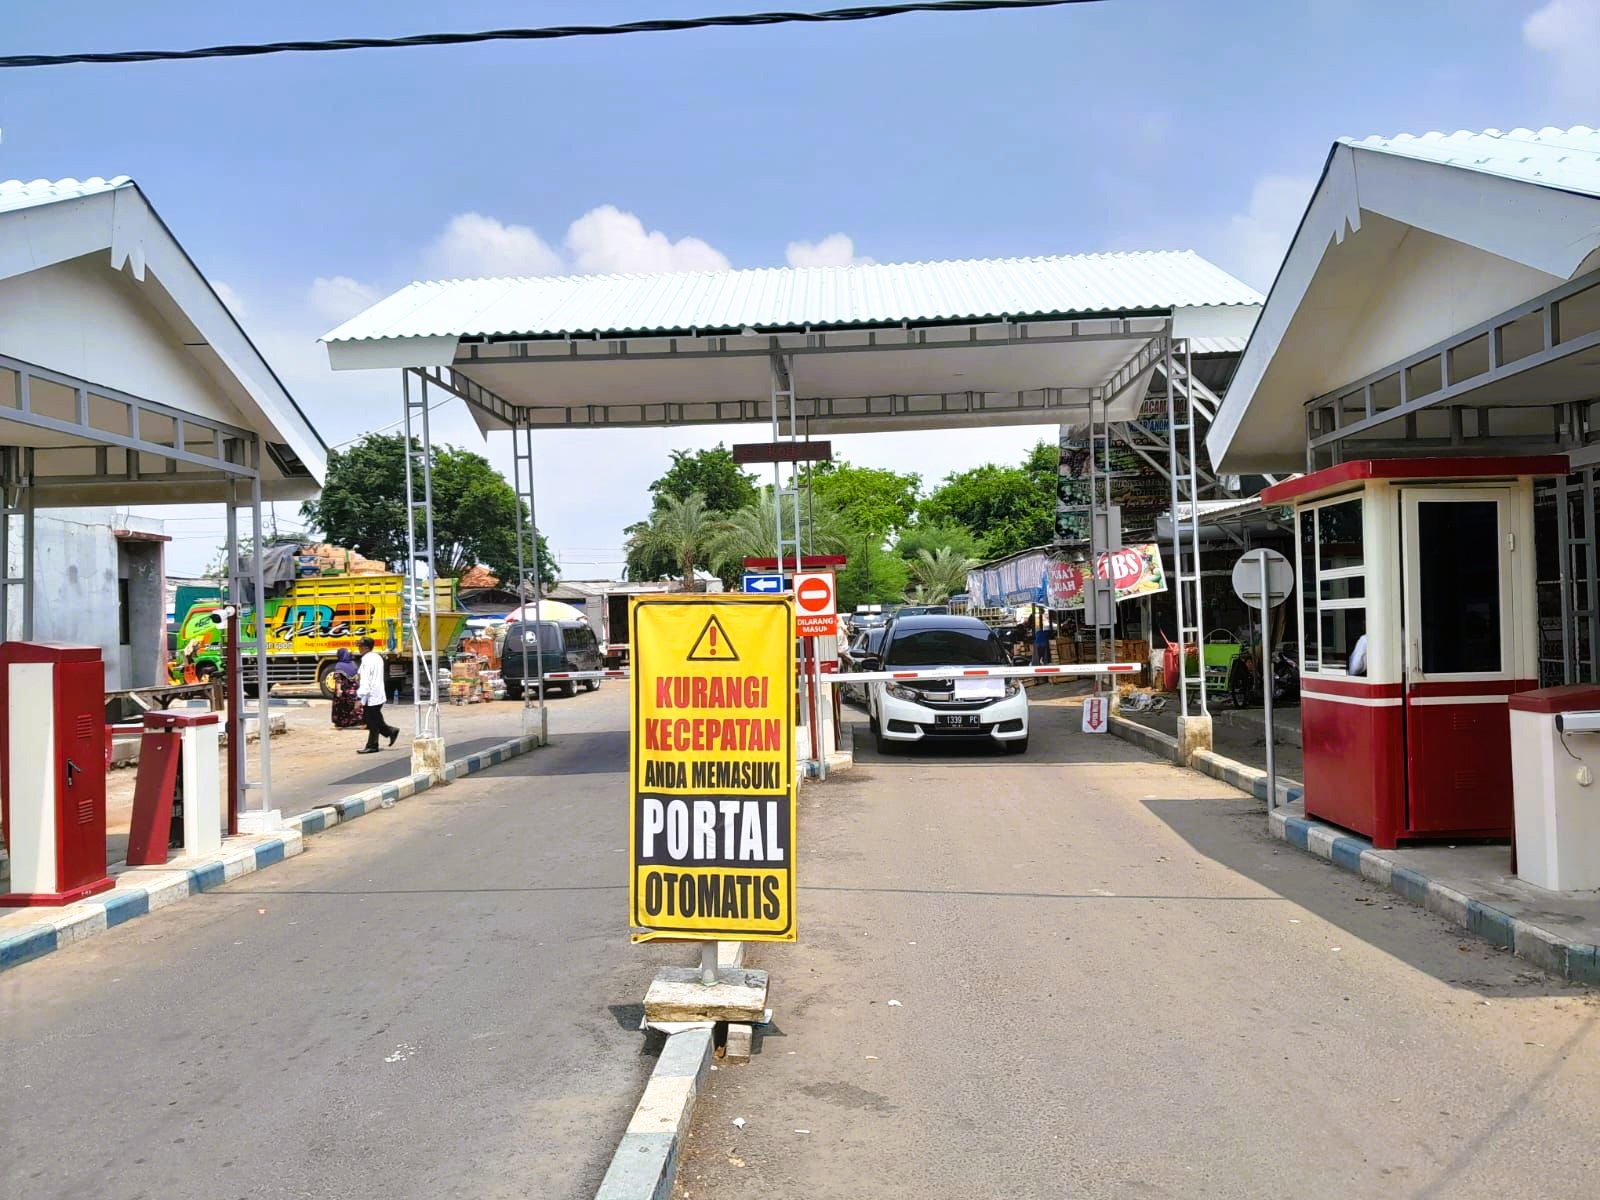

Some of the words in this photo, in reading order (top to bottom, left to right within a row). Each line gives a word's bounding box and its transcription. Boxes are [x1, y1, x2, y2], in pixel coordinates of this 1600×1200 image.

[797, 617, 834, 626] DILARANG
[656, 676, 769, 709] KURANGI
[645, 718, 781, 752] KECEPATAN
[644, 760, 688, 789] ANDA
[691, 761, 781, 790] MEMASUKI
[642, 798, 784, 862] PORTAL
[645, 871, 780, 921] OTOMATIS
